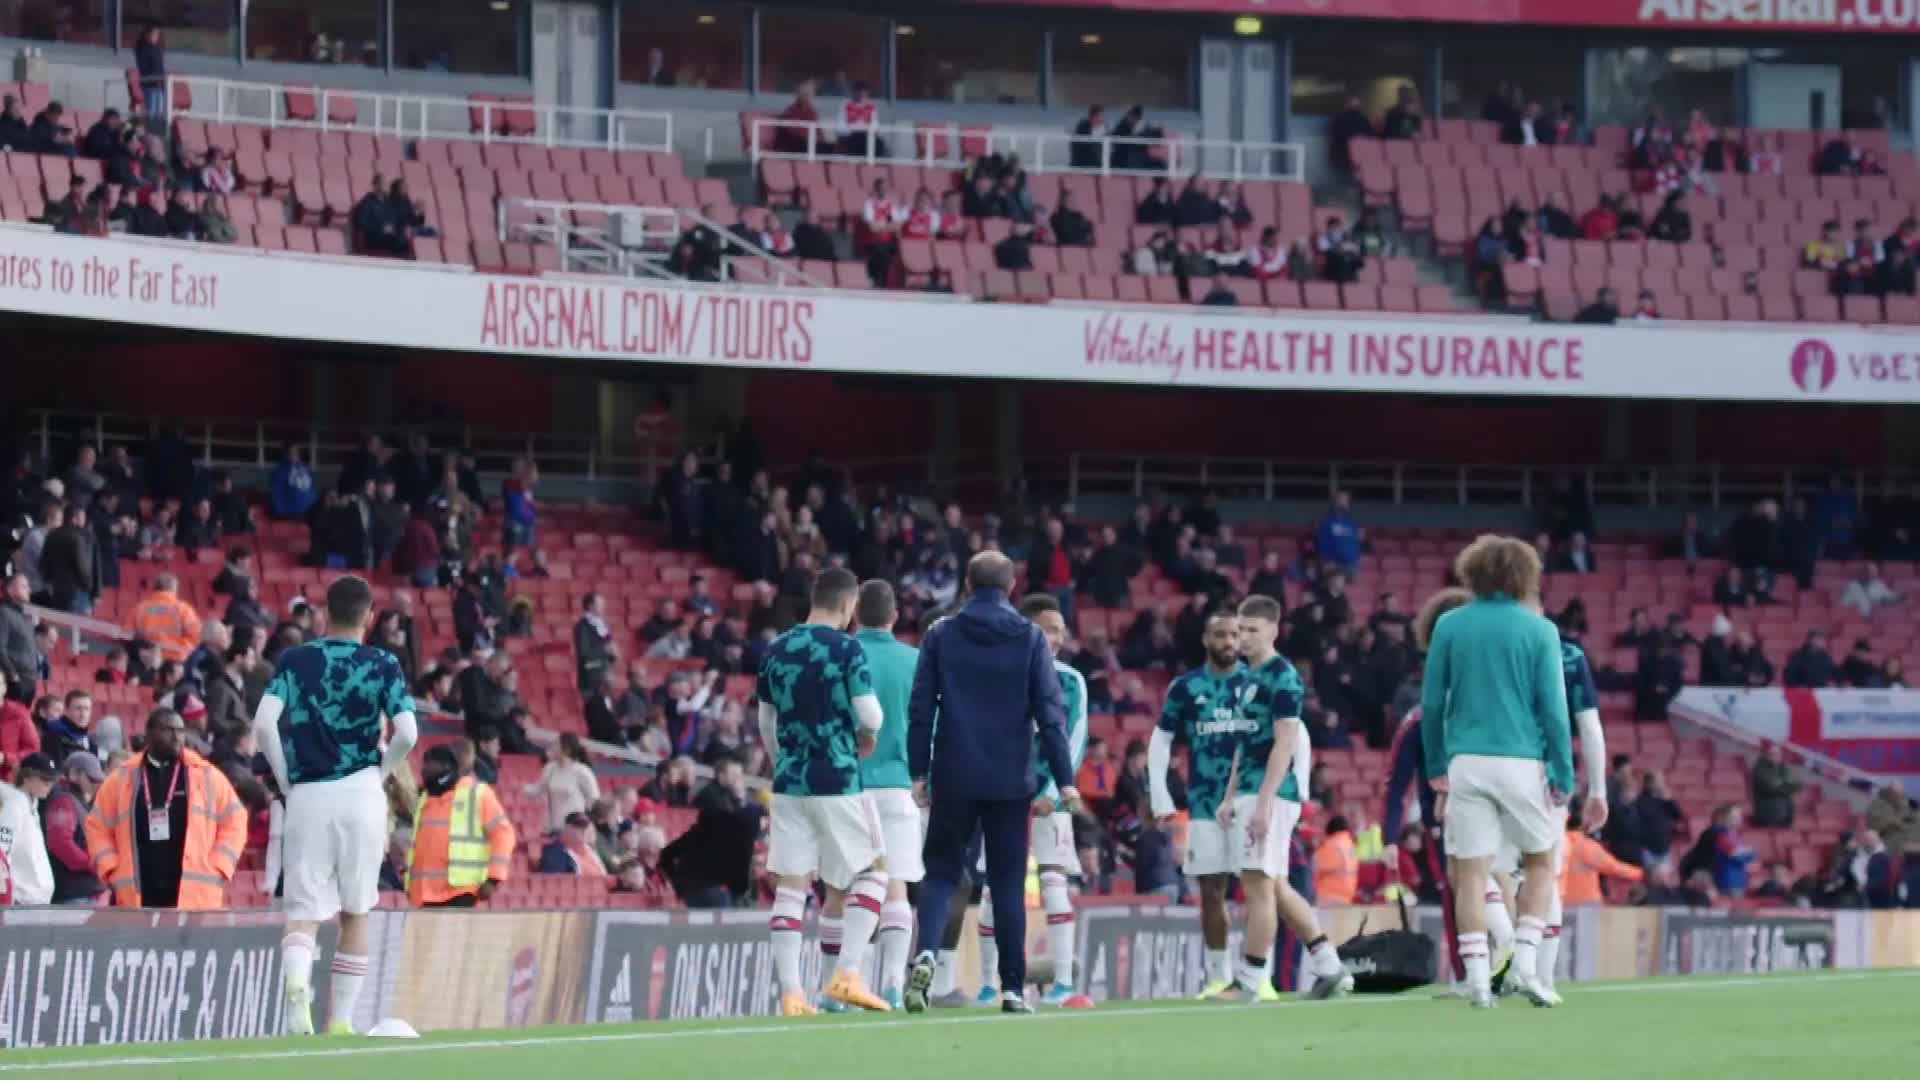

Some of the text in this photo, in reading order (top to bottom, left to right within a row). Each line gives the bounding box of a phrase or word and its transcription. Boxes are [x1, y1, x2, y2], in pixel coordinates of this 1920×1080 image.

[51, 257, 74, 294] to
[82, 256, 120, 298] the
[128, 258, 163, 302] Far
[171, 262, 218, 307] East
[480, 281, 815, 363] ARSENAL.COM/TOURS
[1082, 313, 1585, 384] Vitality HEALTH INSURANCE
[56, 947, 196, 1046] IN-STORE
[194, 948, 218, 1040] &
